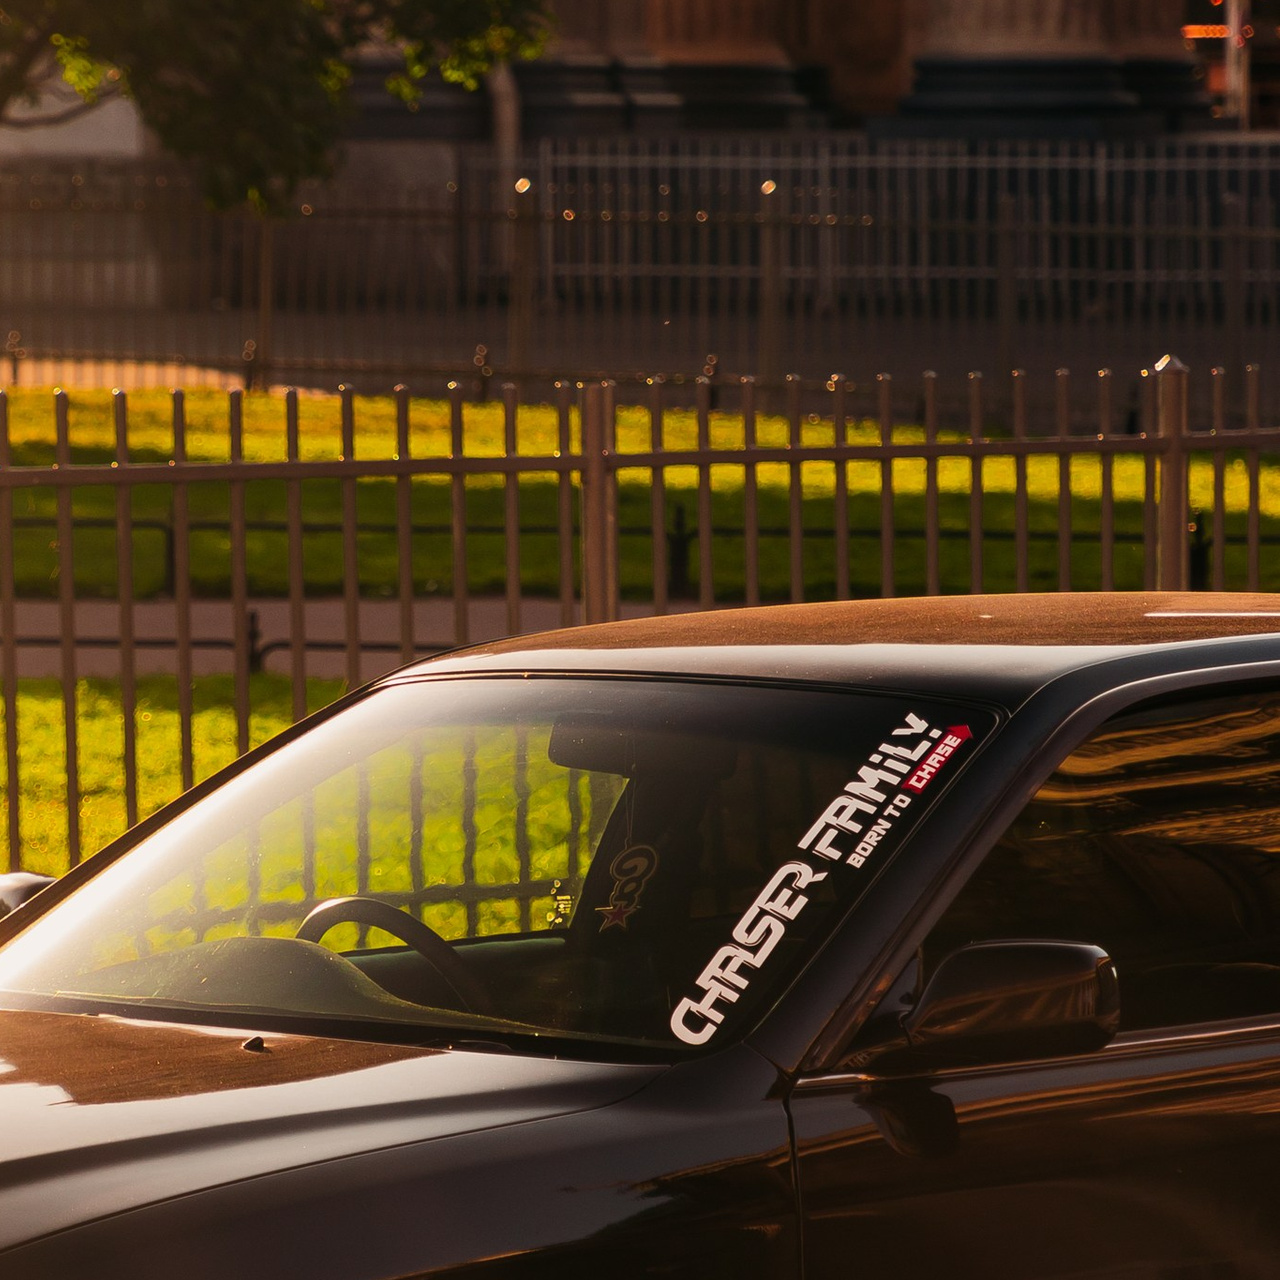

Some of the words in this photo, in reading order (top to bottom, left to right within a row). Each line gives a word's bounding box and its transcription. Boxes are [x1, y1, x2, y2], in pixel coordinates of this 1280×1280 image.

[845, 818, 892, 869] BORN
[883, 793, 912, 817] TO
[908, 734, 962, 790] CHASE
[670, 860, 828, 1045] CHASER
